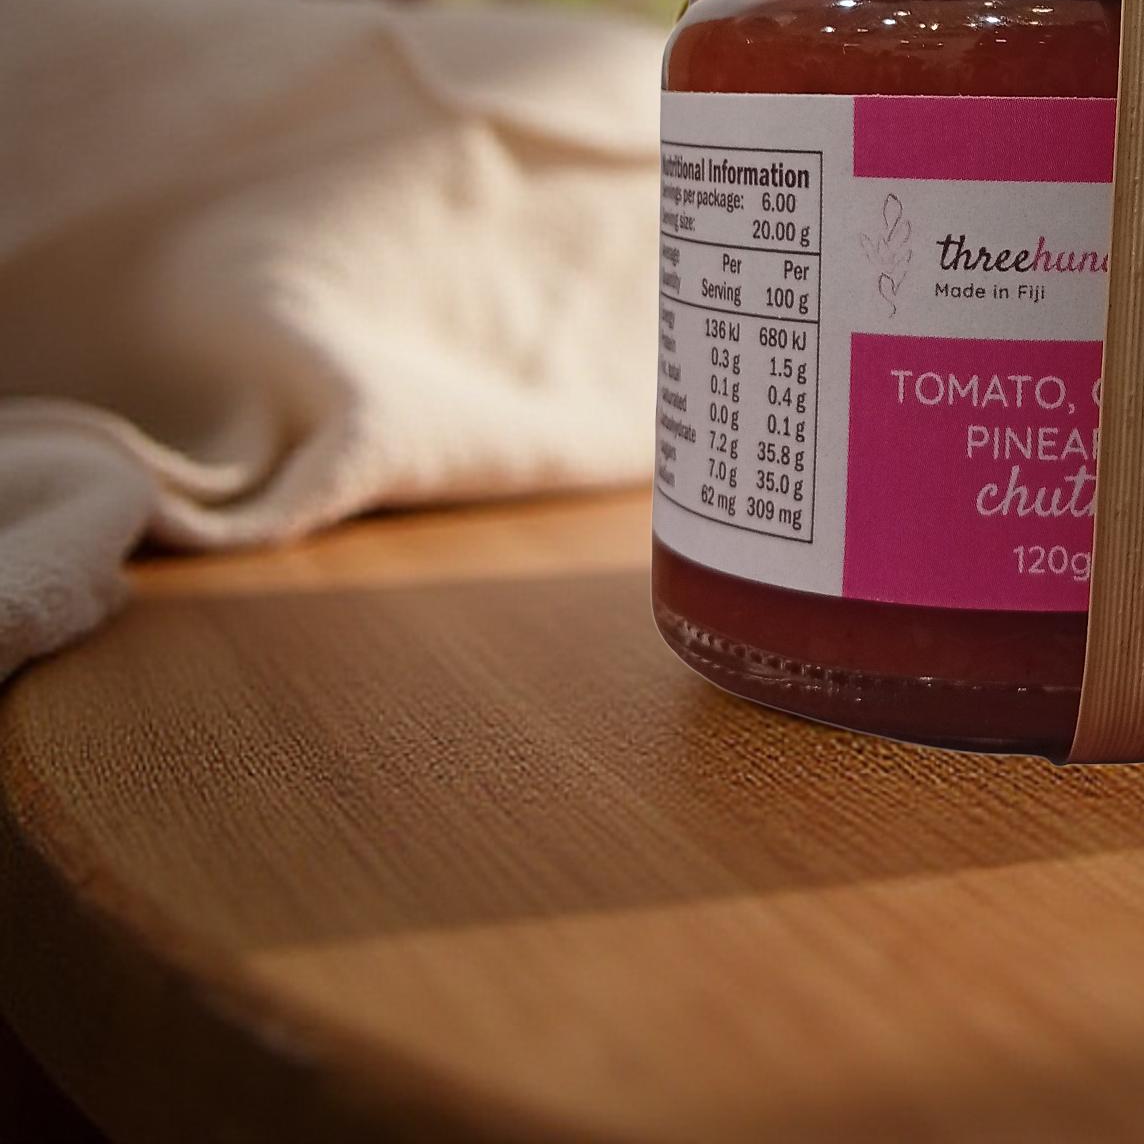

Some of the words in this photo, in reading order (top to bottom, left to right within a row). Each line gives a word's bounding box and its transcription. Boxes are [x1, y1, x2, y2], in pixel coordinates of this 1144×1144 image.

[708, 158, 810, 188] Information
[697, 188, 744, 213] package:
[761, 192, 796, 214] 6.00
[752, 219, 796, 242] 20.00
[799, 226, 810, 248] g
[936, 233, 1109, 273] threehun
[722, 253, 742, 274] Per
[784, 259, 810, 281] Per
[701, 277, 742, 307] Serving
[766, 287, 795, 309] 100
[798, 293, 809, 315] g
[935, 282, 986, 299] Made
[993, 284, 1009, 299] in
[1018, 284, 1046, 303] Fiji
[705, 318, 726, 339] 136
[729, 321, 740, 342] kJ
[759, 326, 788, 349] 680
[792, 330, 807, 352] kJ
[711, 346, 730, 368] 0.3
[732, 353, 741, 375] g
[769, 356, 793, 378] 1.5
[796, 362, 807, 385] g
[710, 374, 729, 397] 0.1
[731, 381, 740, 403] g
[767, 385, 792, 407] 0.4
[796, 392, 807, 414] g
[890, 368, 1076, 415] TOMATO,
[709, 402, 729, 424] 0.0
[730, 410, 739, 432] g
[767, 413, 791, 436] 0.1
[795, 420, 805, 443] g
[709, 430, 727, 453] 7.2
[730, 439, 738, 460] g
[757, 441, 791, 465] 35.8
[795, 450, 805, 472] g
[708, 458, 727, 480] 7.0
[729, 466, 738, 488] g
[756, 469, 790, 494] 35.0
[793, 479, 804, 501] g
[976, 464, 1098, 518] chut
[701, 484, 715, 506] 62
[717, 493, 736, 516] mg
[746, 496, 774, 521] 309
[778, 507, 803, 531] mg
[1012, 545, 1093, 582] 120g
